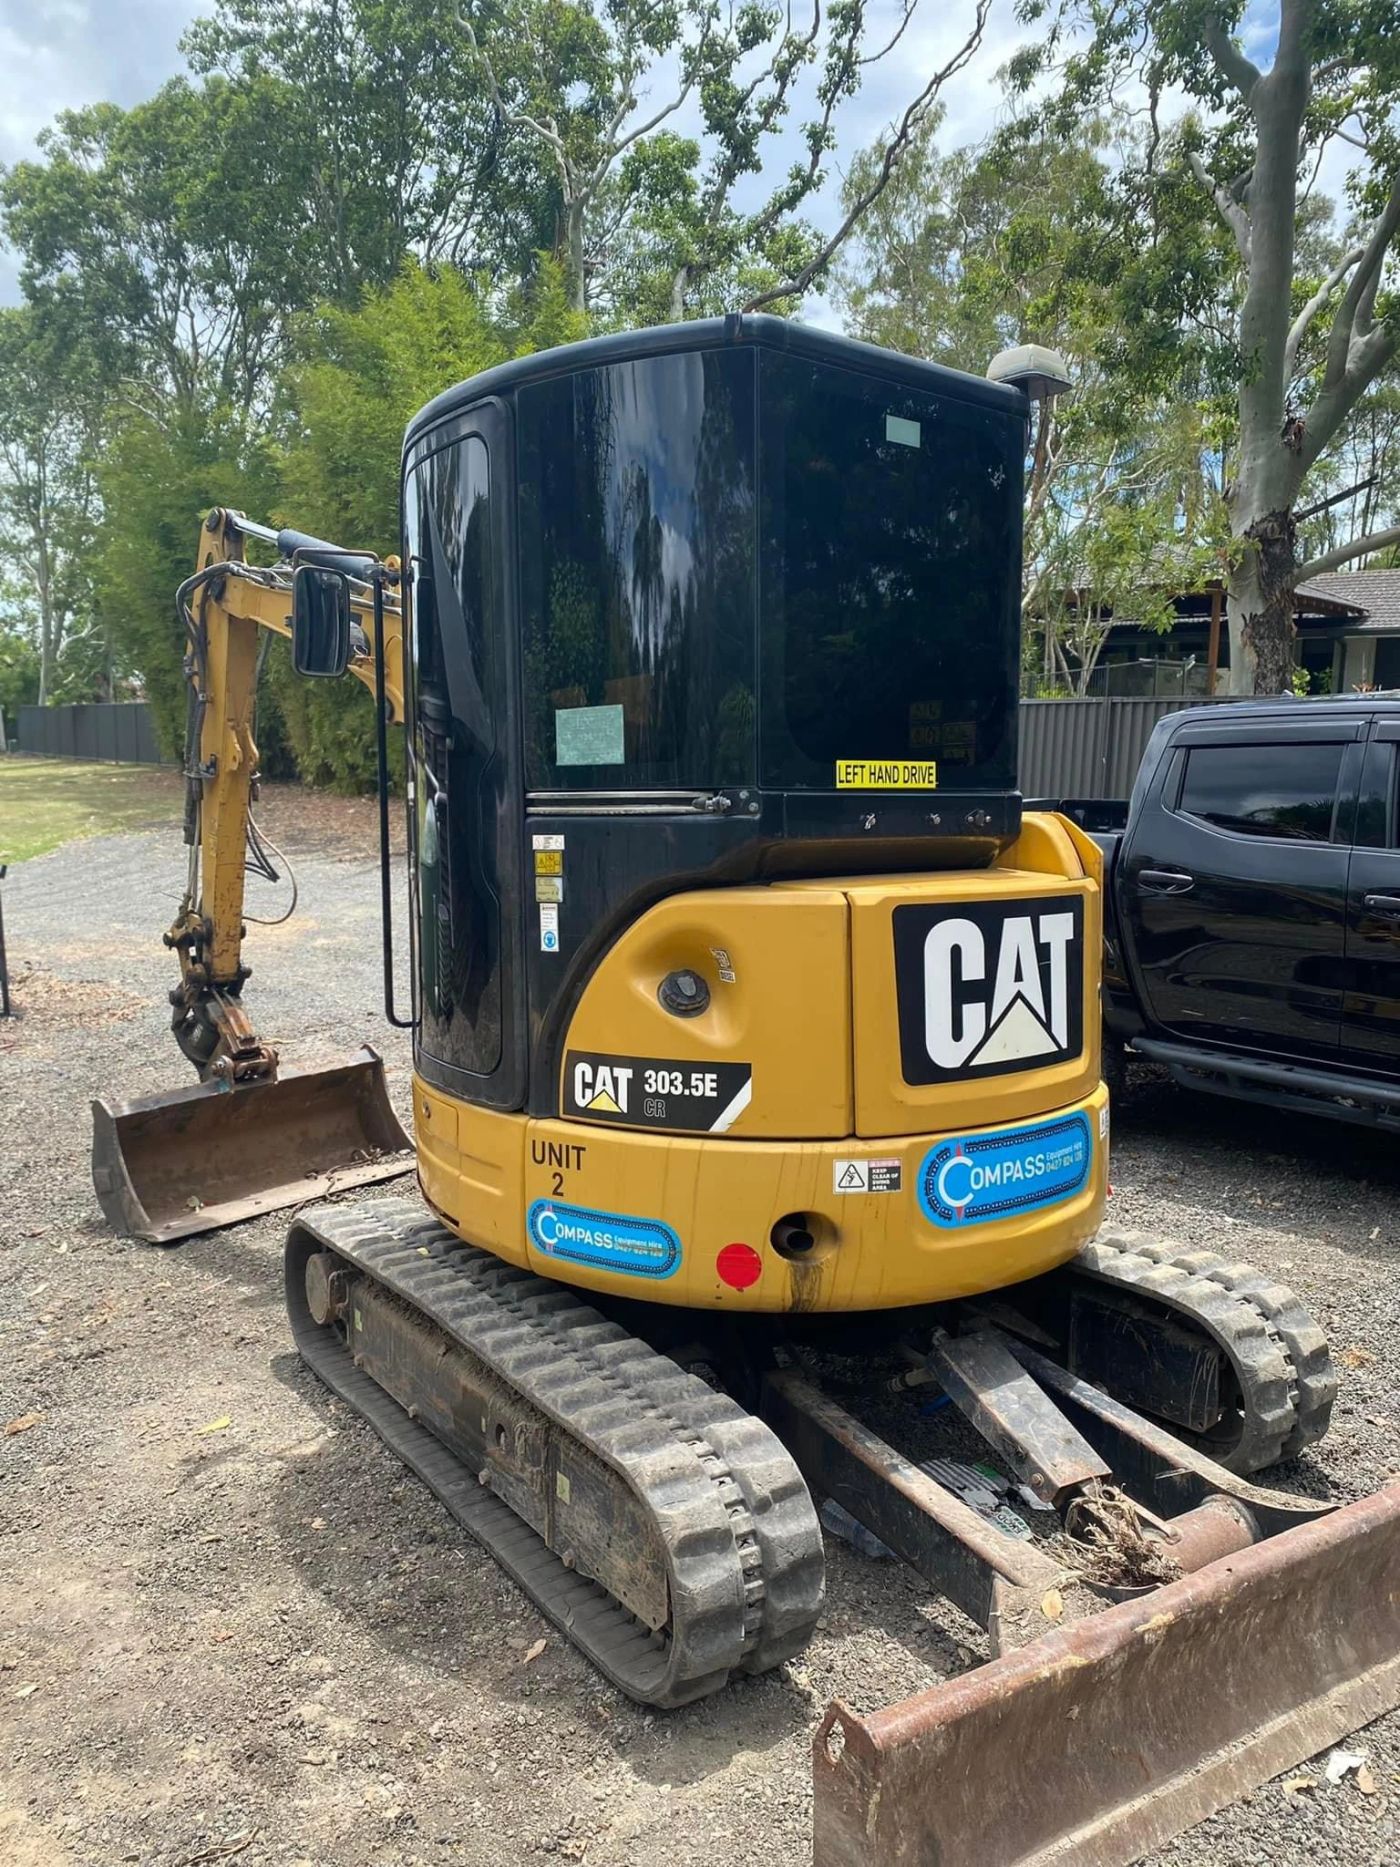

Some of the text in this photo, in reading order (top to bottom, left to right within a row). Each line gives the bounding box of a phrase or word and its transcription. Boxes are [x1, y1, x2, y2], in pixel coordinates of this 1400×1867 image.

[838, 764, 934, 784] LEFT HAND DRIVE
[924, 912, 1074, 1069] CAT
[574, 1062, 718, 1113] CAT 303.5E
[643, 1098, 666, 1117] CR
[532, 1139, 586, 1170] UNIT
[552, 1172, 564, 1197] 2
[938, 1154, 1045, 1208] COMPASS
[537, 1211, 613, 1249] COMPASS
